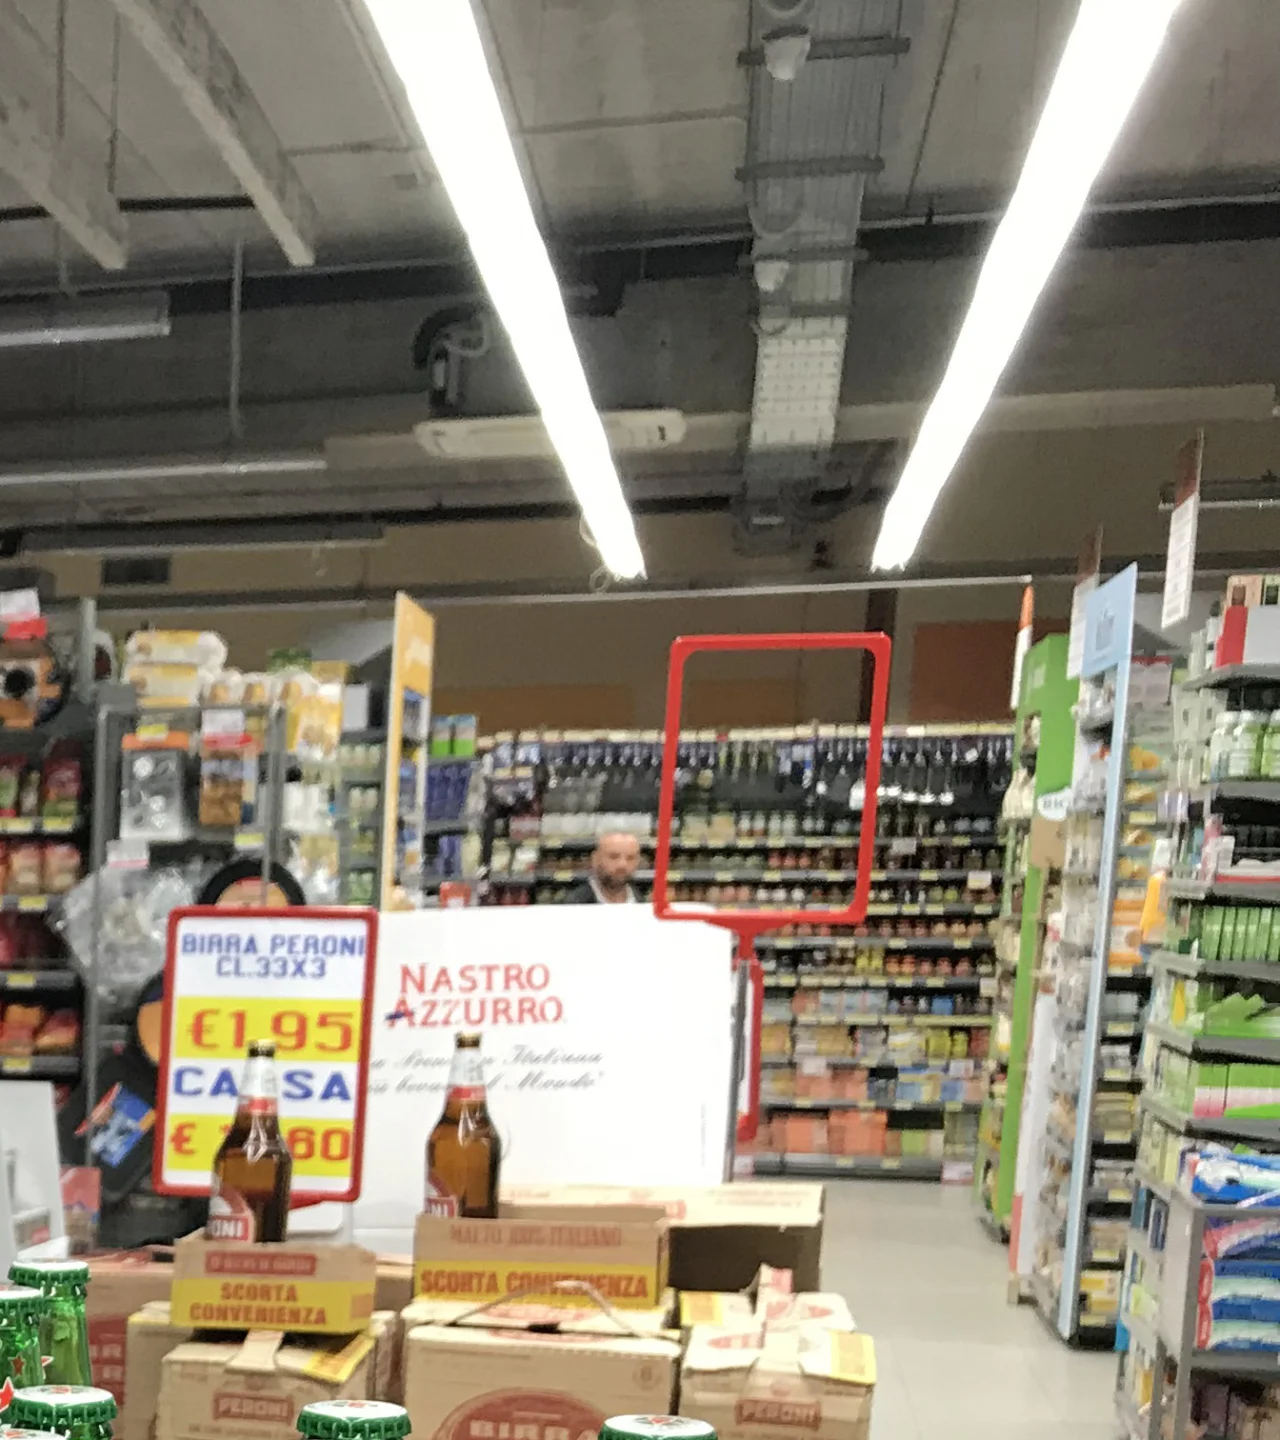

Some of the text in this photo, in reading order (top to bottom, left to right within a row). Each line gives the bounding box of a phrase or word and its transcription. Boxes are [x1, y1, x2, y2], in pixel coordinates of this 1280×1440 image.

[182, 934, 365, 957] BIRRA PERONI
[400, 963, 551, 994] NASTRO
[387, 996, 564, 1028] AZZURRO
[174, 1066, 351, 1101] CASA
[220, 1283, 298, 1303] SCORTA
[420, 1272, 499, 1297] SCORTA
